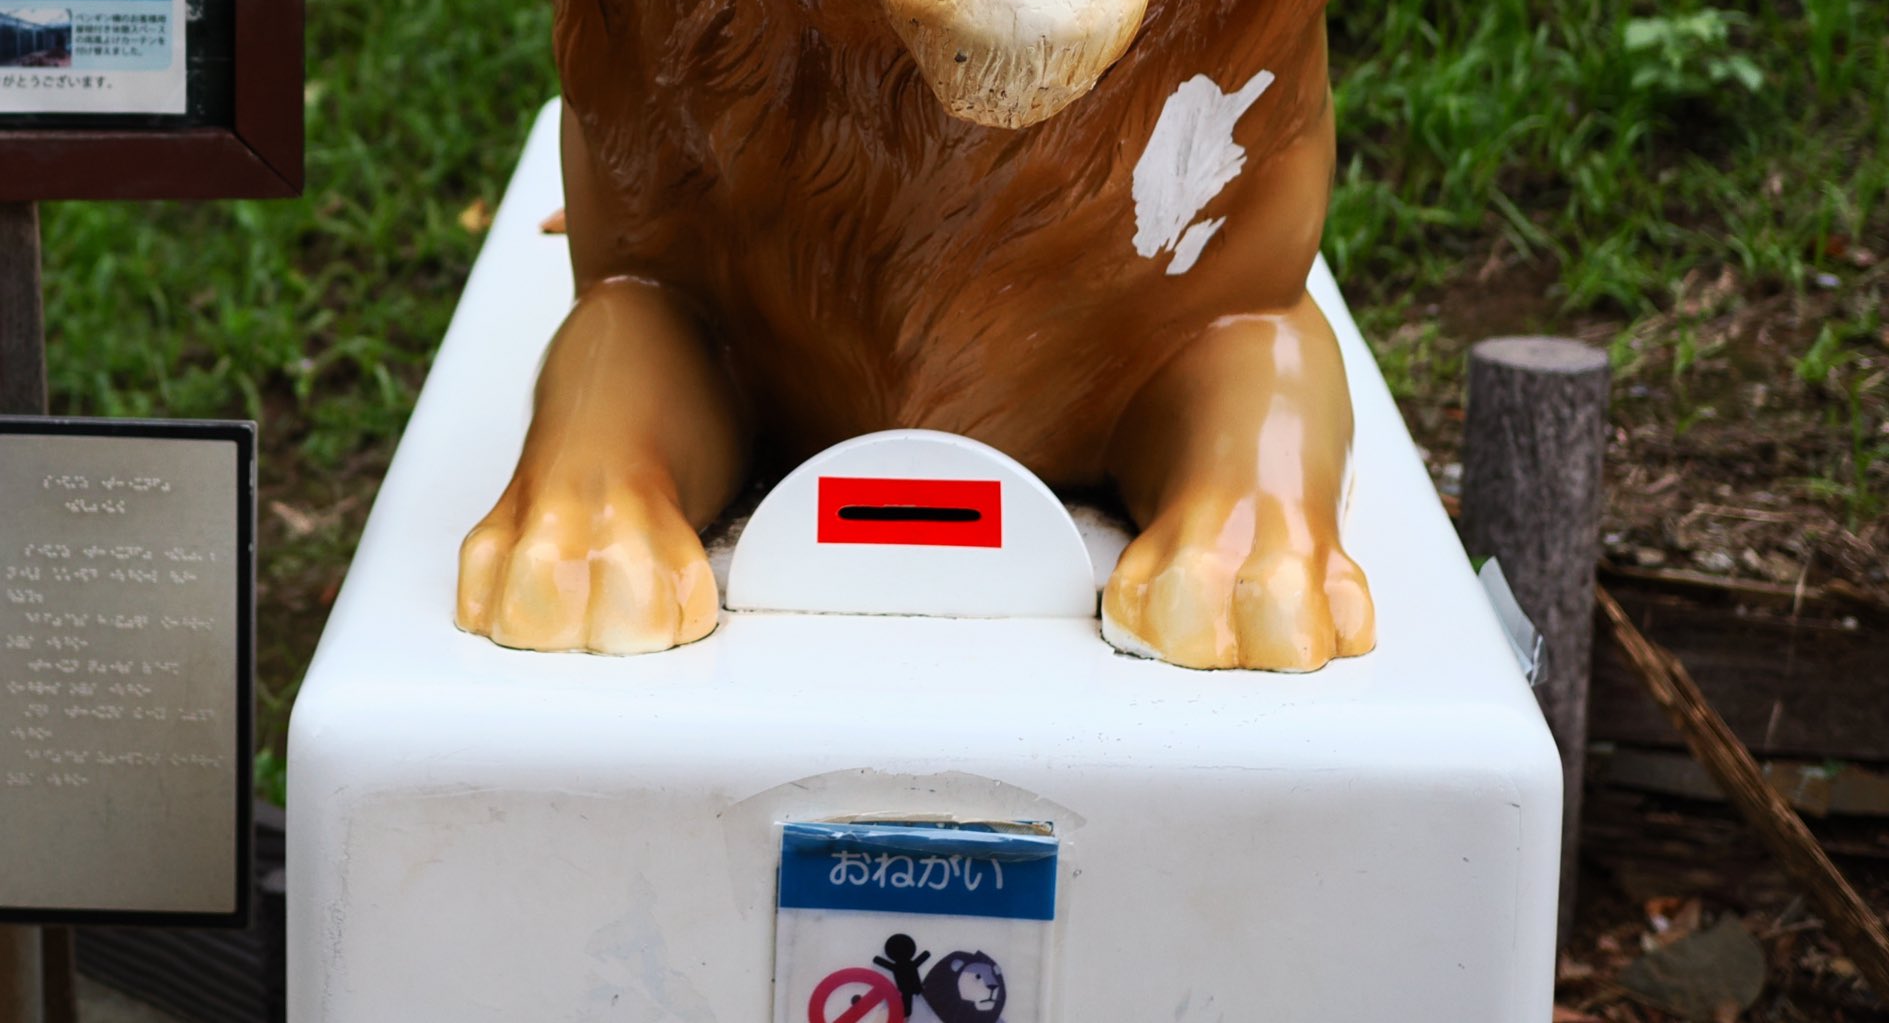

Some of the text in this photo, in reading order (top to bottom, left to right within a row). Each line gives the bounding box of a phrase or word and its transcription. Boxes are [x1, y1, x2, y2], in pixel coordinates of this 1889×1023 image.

[0, 75, 113, 89] がとうございます。
[829, 849, 1004, 891] おねがい
